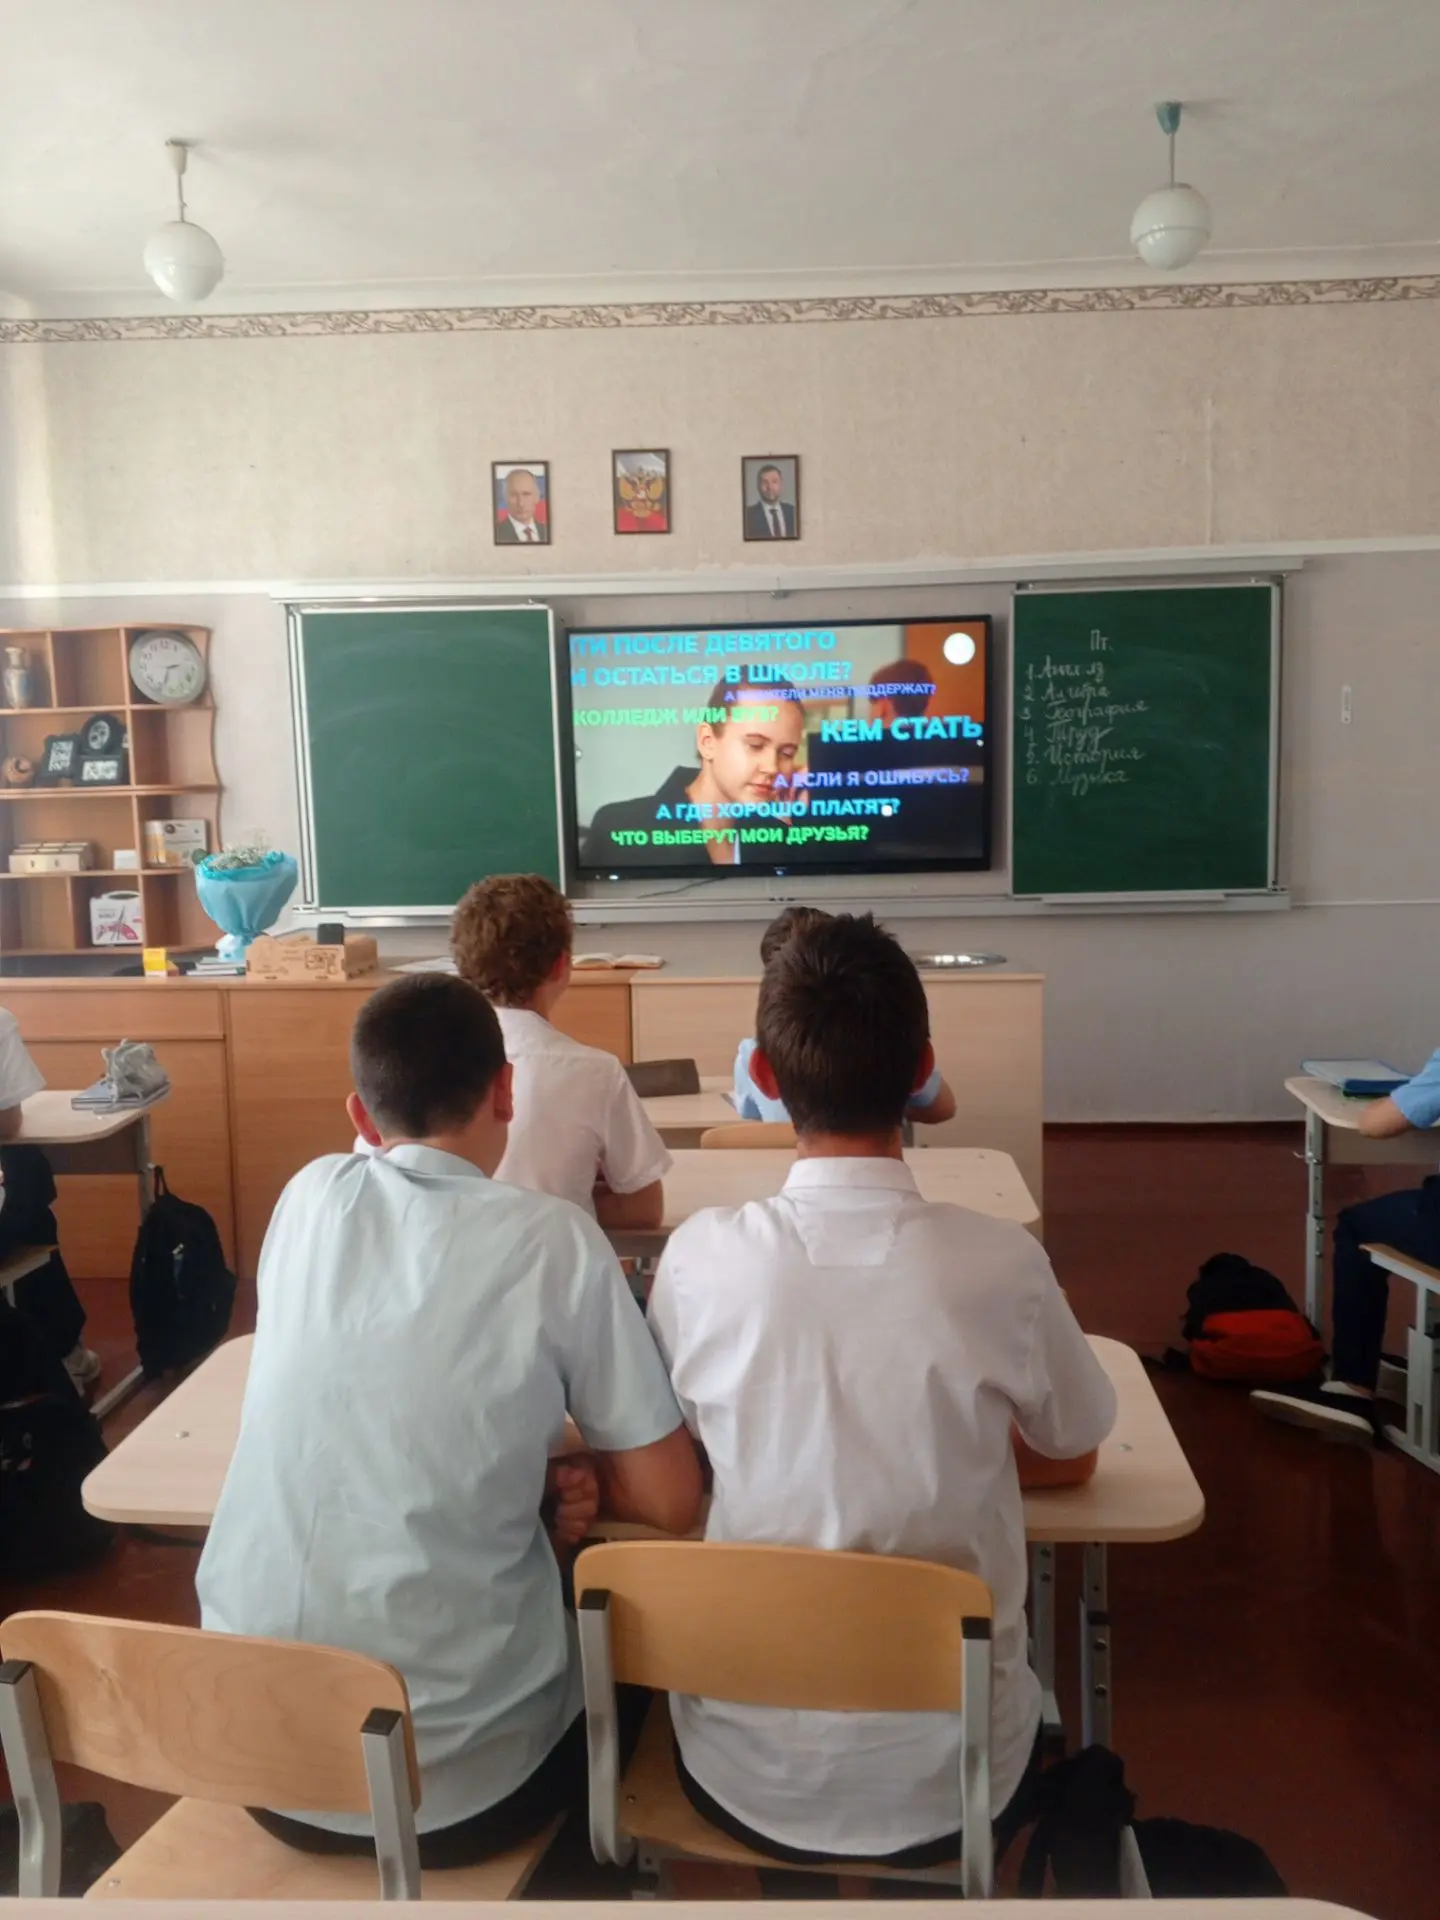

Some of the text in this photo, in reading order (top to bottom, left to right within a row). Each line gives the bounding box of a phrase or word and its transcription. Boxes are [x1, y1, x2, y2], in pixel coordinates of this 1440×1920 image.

[614, 634, 699, 656] ПОСЛЕ
[705, 631, 836, 657] ДЕВЯТОГО
[592, 664, 718, 687] ОСТАТЬСЯ
[726, 664, 741, 684] В
[748, 661, 853, 684] ШКОЛЕ?
[723, 690, 736, 702] А
[573, 707, 678, 727] КОЛЛЕДЖ
[683, 706, 727, 725] ИЛИ
[821, 715, 984, 743] КЕМ СТАТЬ
[773, 772, 788, 788] А
[847, 771, 860, 786] Я
[864, 767, 970, 786] ОШИБУСЬ?
[655, 797, 901, 822] А ГДЕ ХОРОШО ПЛАТЯТ?
[610, 825, 869, 846] ЧТО ВЫБЕРУТ МОИ ДРУЗЬЯ?
